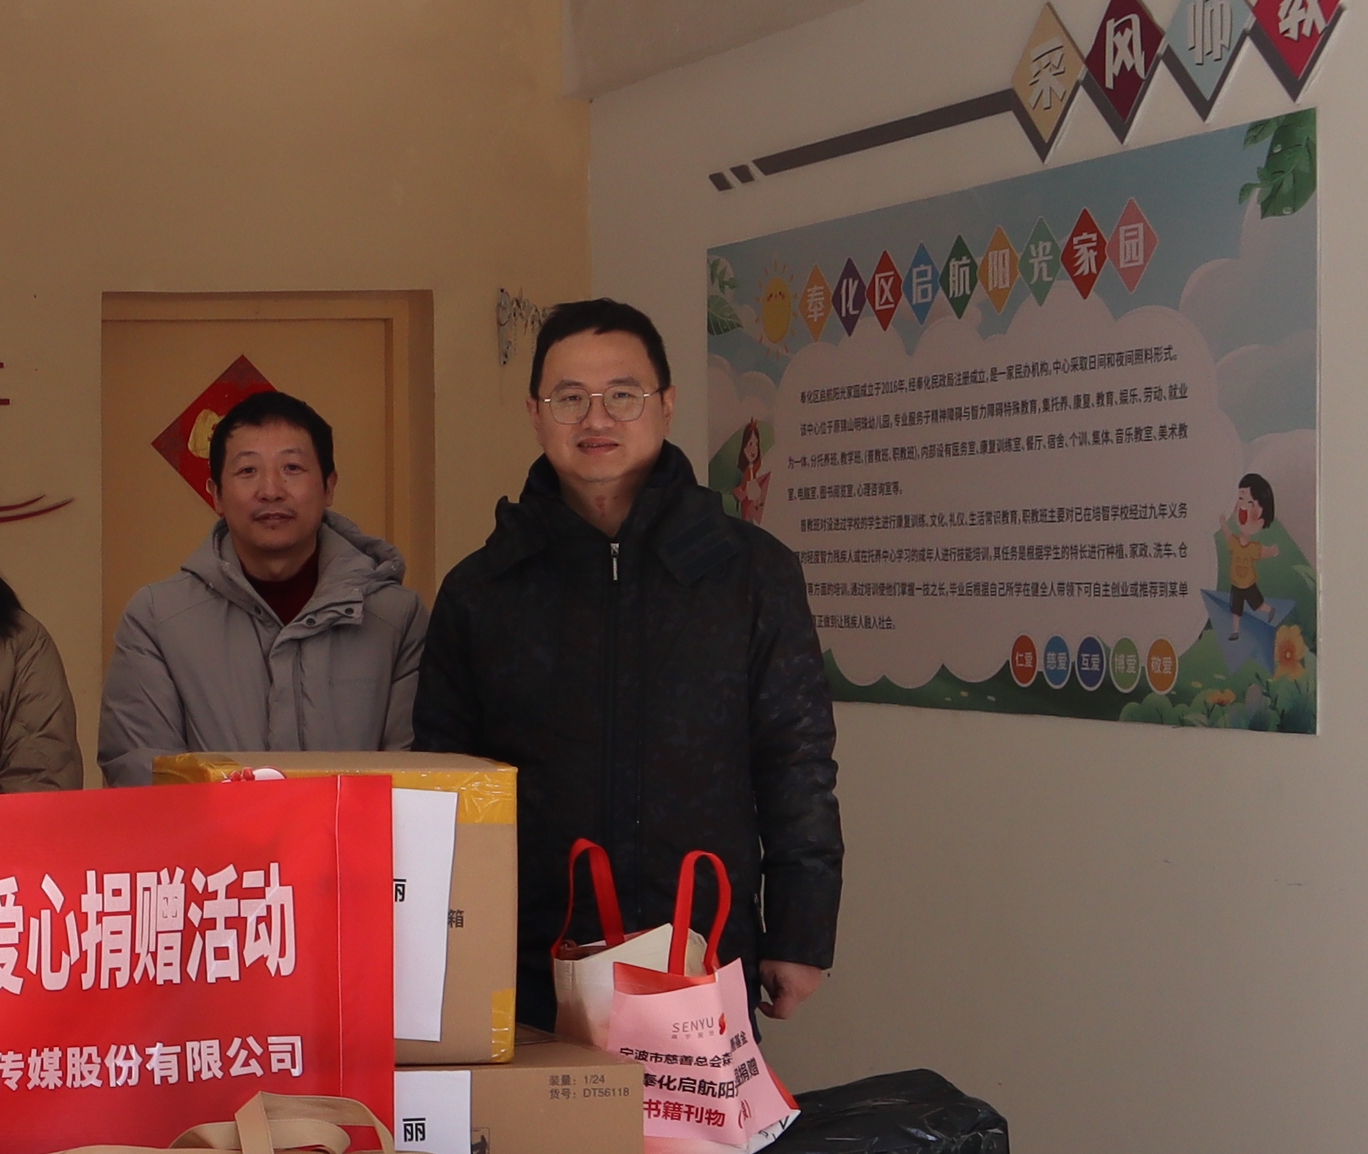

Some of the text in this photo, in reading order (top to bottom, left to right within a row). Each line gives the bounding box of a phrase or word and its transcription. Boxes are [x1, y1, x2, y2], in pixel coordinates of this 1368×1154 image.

[807, 222, 1144, 321] 奉化区启航阳光家园
[1015, 652, 1034, 669] 仁爱
[1080, 653, 1101, 671] 互爱
[672, 1017, 714, 1033] SENYU
[583, 1087, 630, 1098] DT56118
[643, 1099, 726, 1127] 书籍刊物
[402, 1117, 426, 1142] 丽
